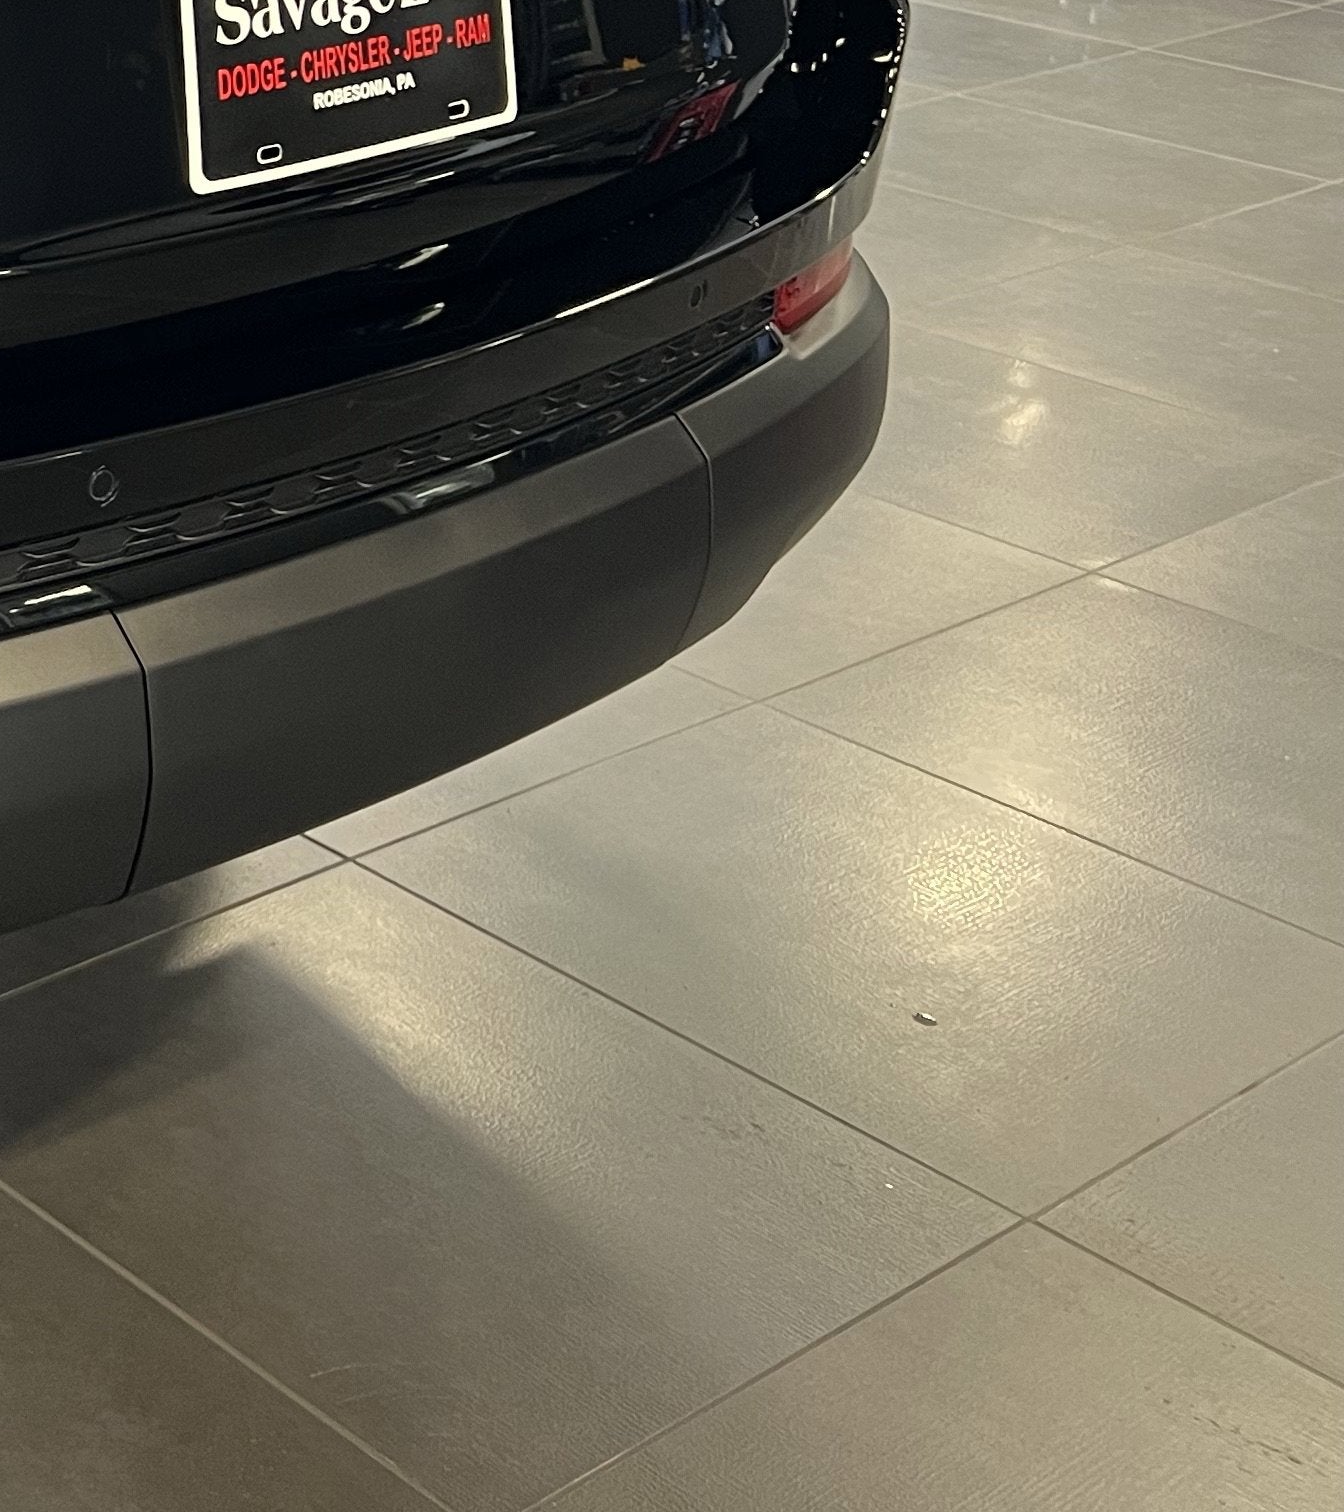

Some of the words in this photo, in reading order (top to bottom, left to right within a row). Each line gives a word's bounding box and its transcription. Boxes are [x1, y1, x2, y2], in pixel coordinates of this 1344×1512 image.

[216, 56, 287, 101] DODGE
[300, 34, 392, 83] CHRYSLER
[402, 22, 444, 61] JEEP
[455, 12, 492, 49] RAM
[312, 75, 396, 111] ROBESONIA,
[396, 71, 416, 92] PA
